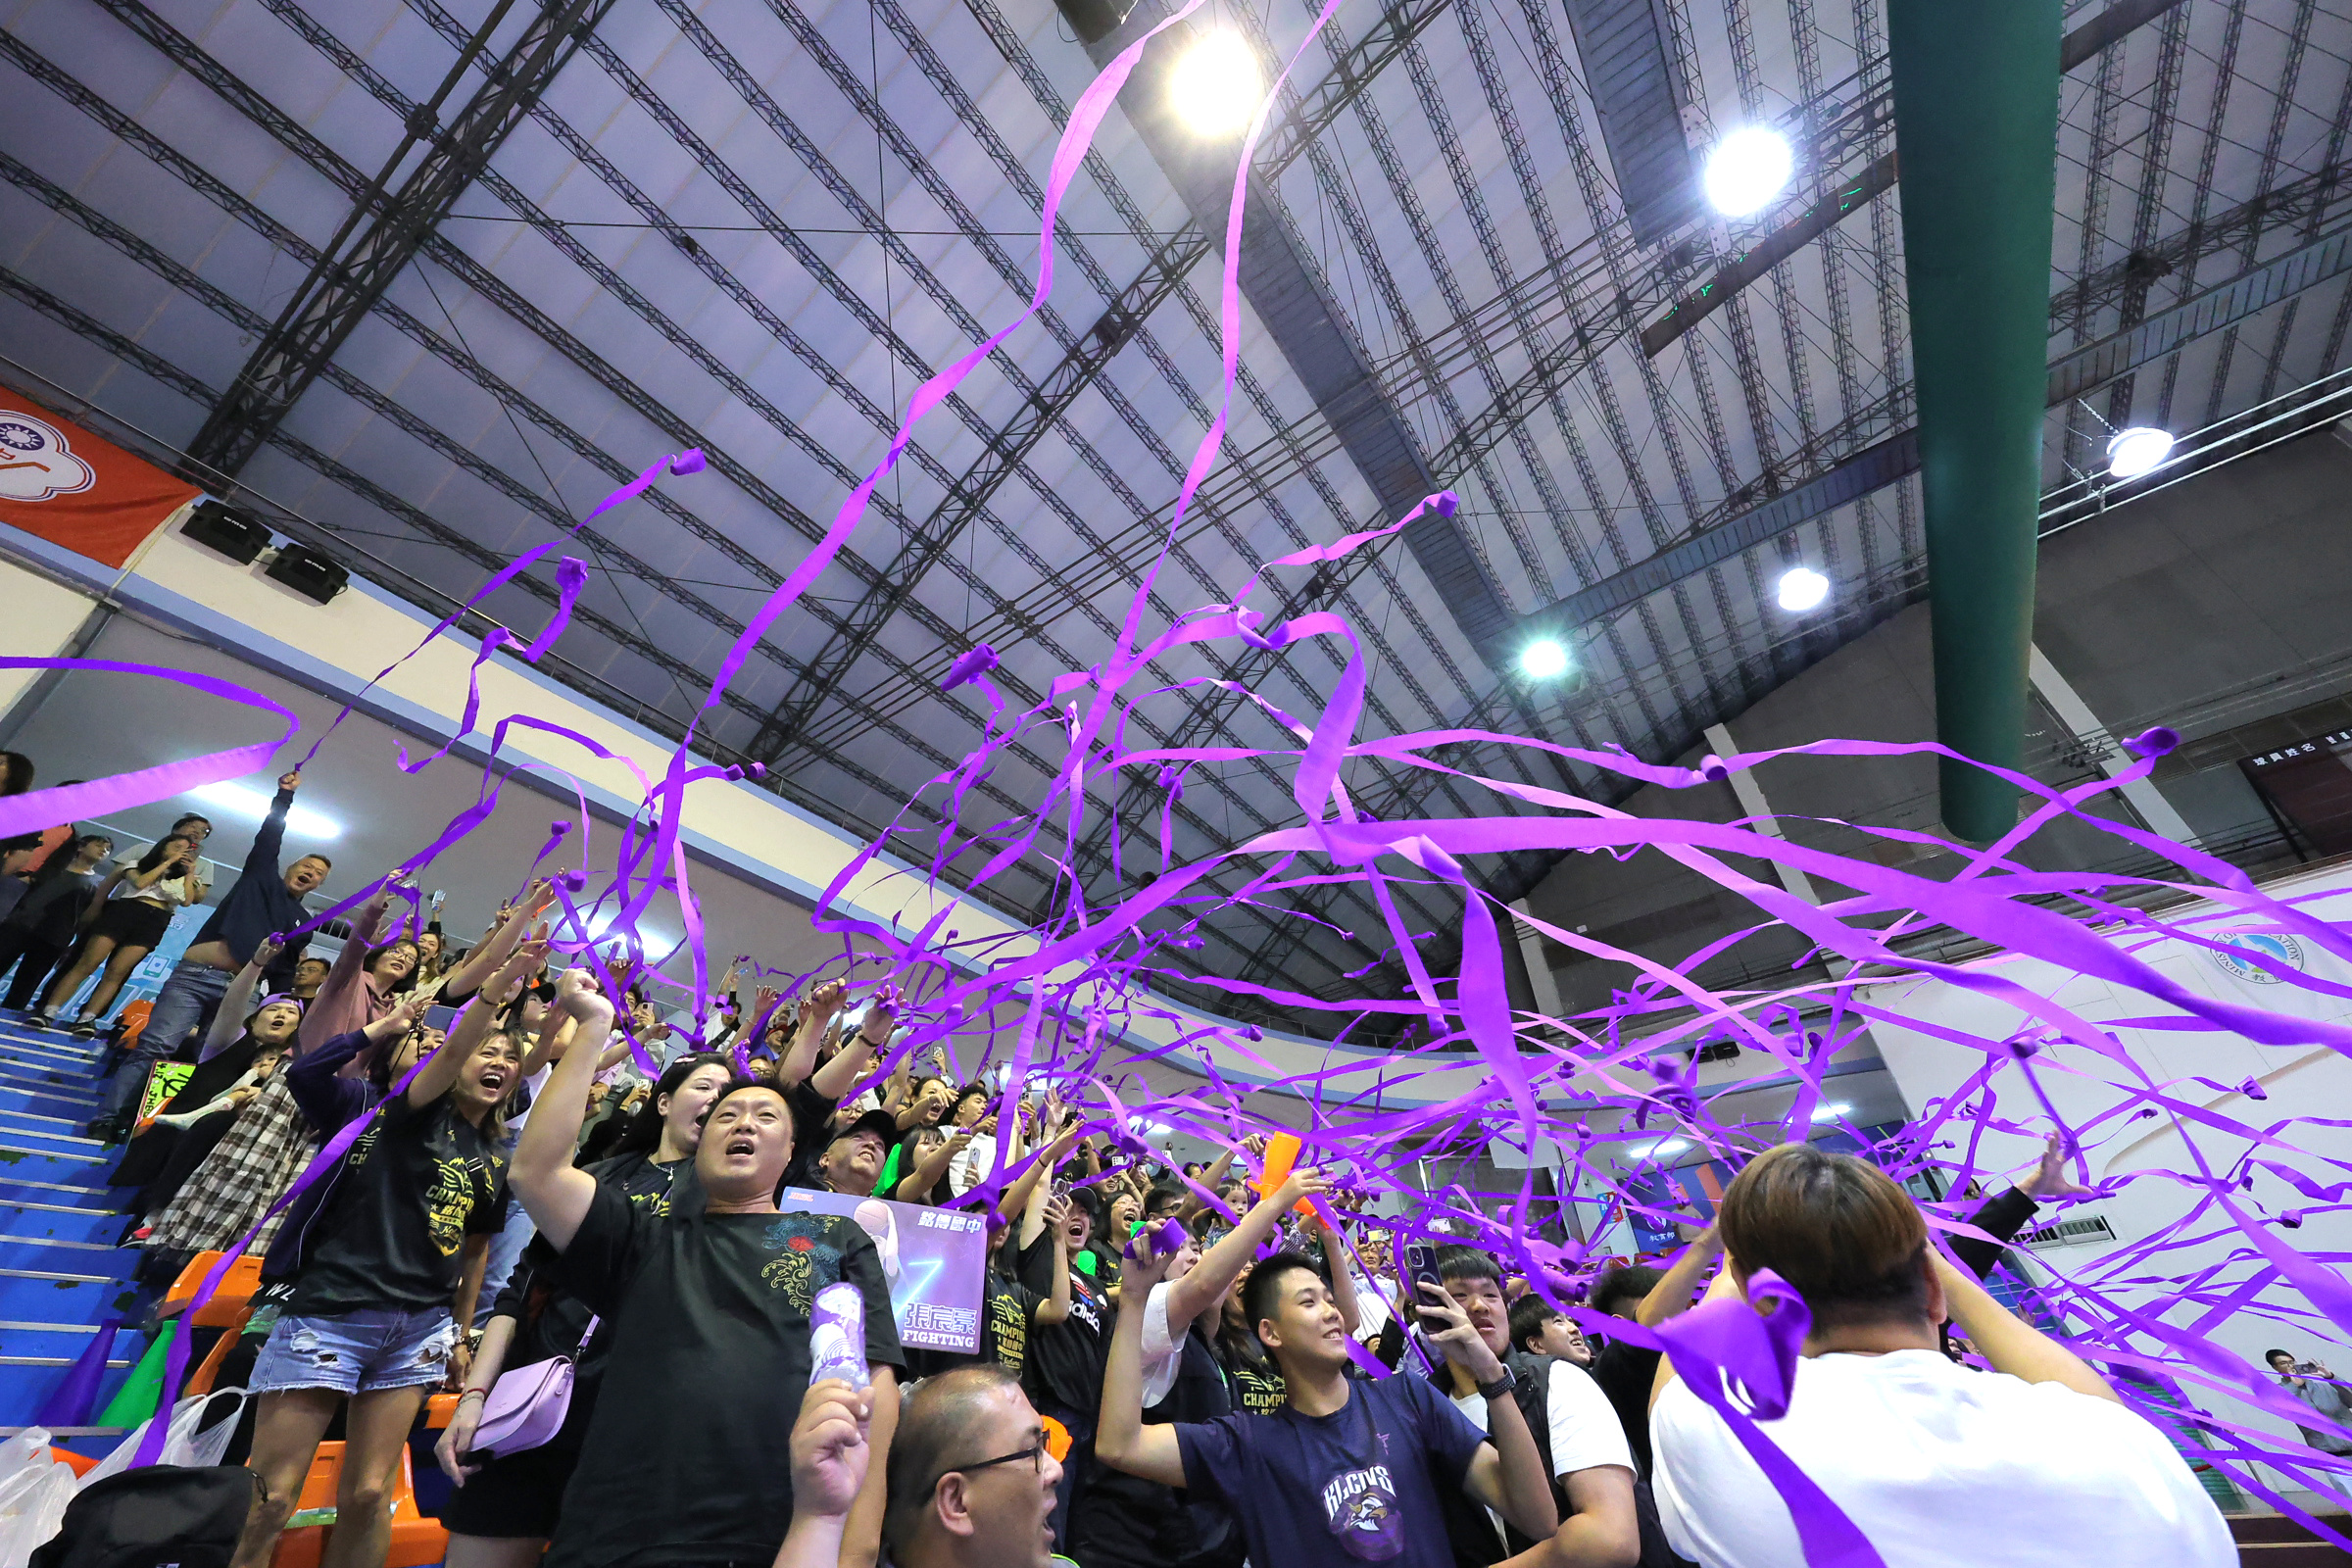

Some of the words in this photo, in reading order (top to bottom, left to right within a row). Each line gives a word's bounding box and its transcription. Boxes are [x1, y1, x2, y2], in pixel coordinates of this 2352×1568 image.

[918, 1210, 982, 1234] 銘傳國中
[896, 1257, 944, 1318] 7
[1069, 1299, 1101, 1337] dida
[902, 1329, 975, 1348] FIGHTING
[1243, 1392, 1287, 1407] CHAMPI
[1323, 1464, 1397, 1522] KLCIVS
